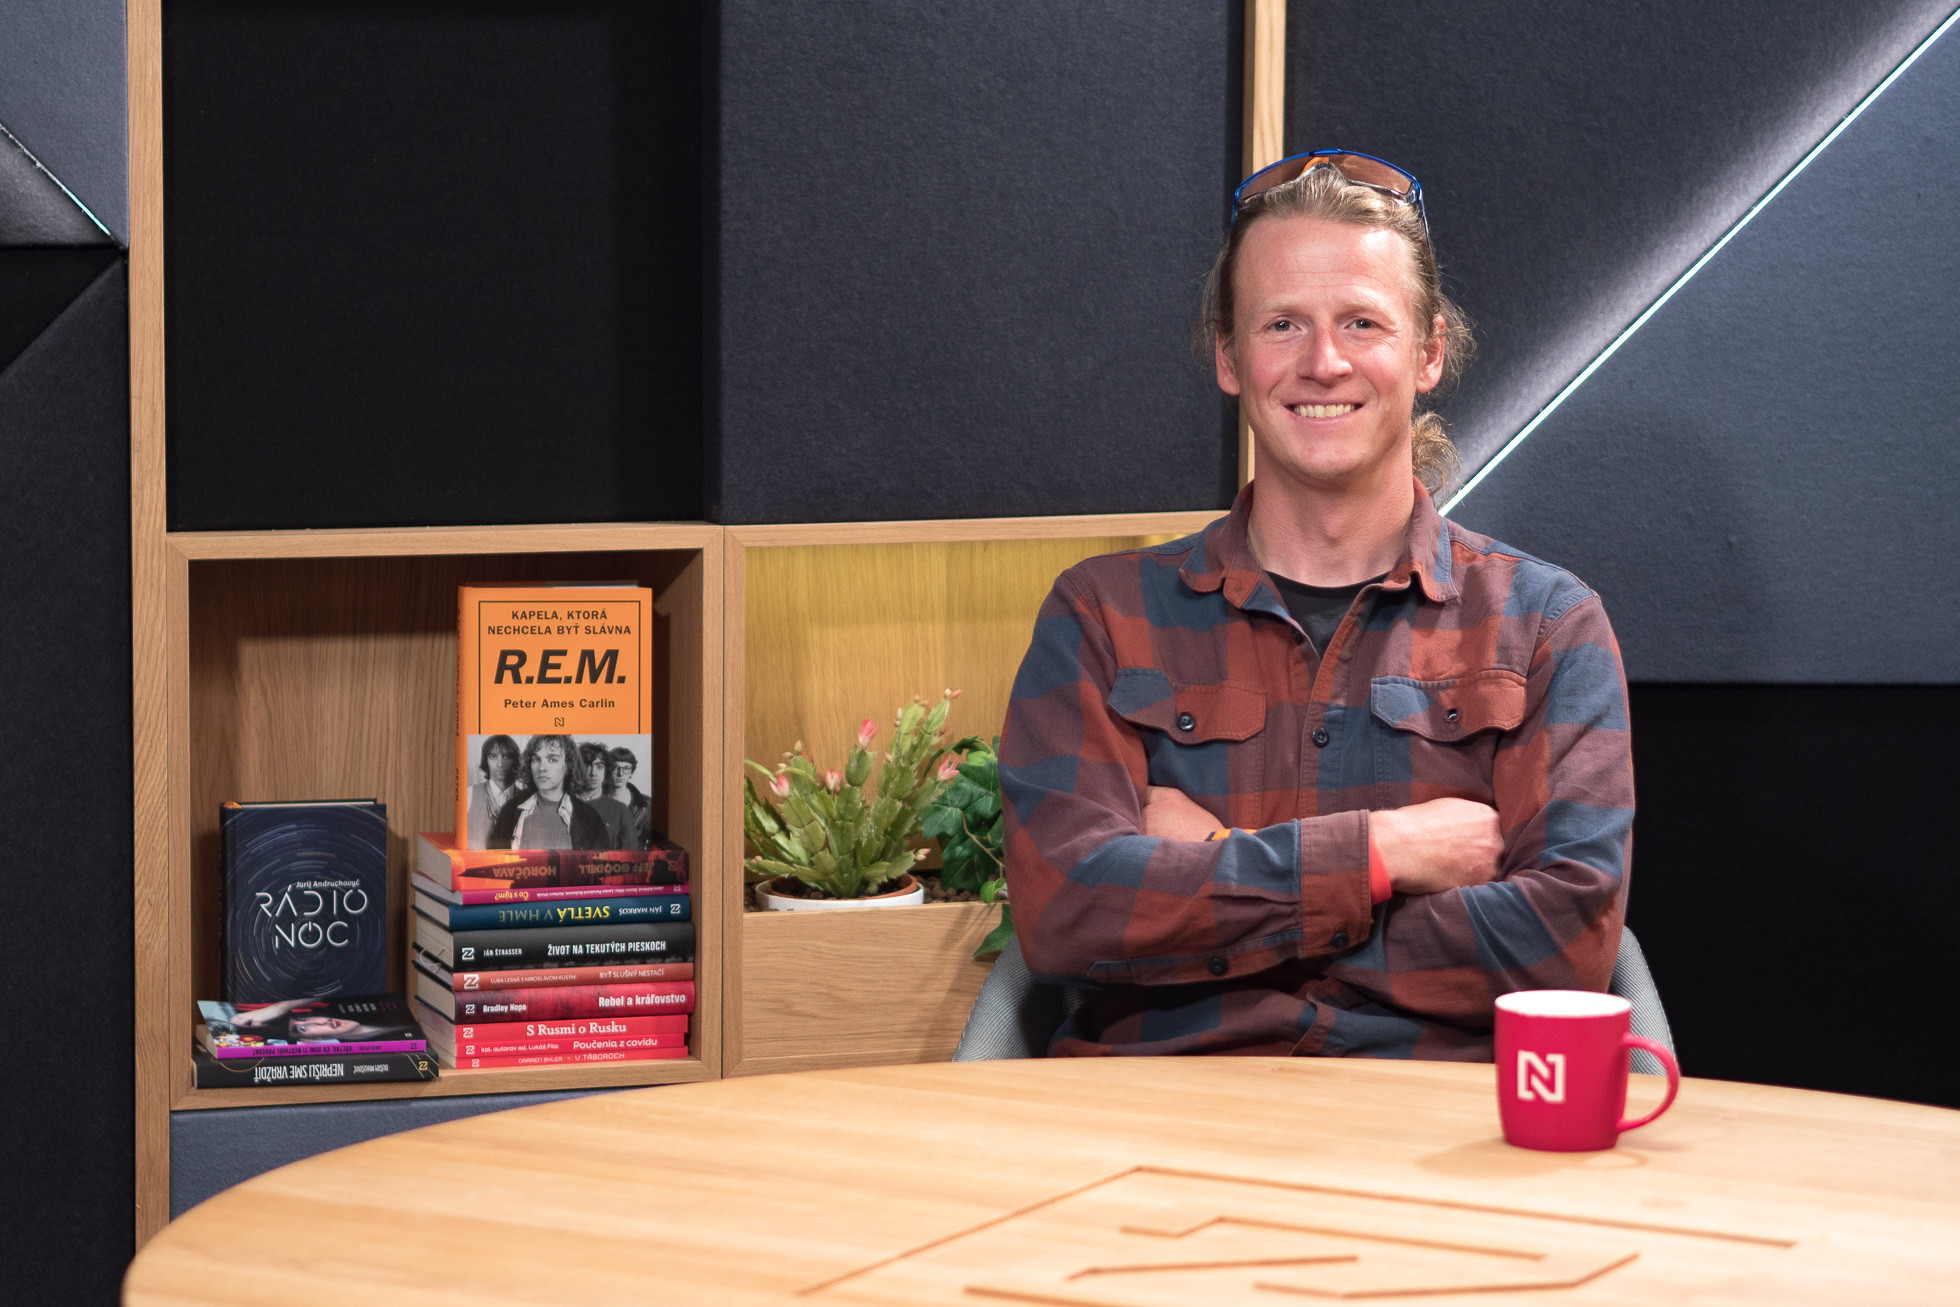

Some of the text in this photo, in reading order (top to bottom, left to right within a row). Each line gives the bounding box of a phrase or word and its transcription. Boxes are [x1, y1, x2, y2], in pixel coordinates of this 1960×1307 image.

[511, 607, 608, 622] KAPELA, KTORÁ
[487, 623, 632, 635] NECHCELA BYŤ SLÁVNA
[494, 649, 626, 684] R.E.M.
[504, 698, 615, 709] Peter Ames Carlin
[492, 865, 557, 879] HORÚČAVA
[579, 863, 630, 876] GOODELL
[296, 880, 312, 889] Jurij
[255, 884, 368, 917] RÁDIO
[494, 891, 512, 900] tým?
[519, 891, 529, 900] Čo
[498, 905, 610, 922] SVETLÁ V HMLE
[618, 905, 662, 916] JÁN MARKOŠ
[275, 920, 349, 948] NOC
[494, 946, 522, 956] ŠTRASSER
[547, 940, 666, 956] ŽIVOT NA TEKUTÝCH PIESKOCH
[599, 967, 664, 979] BYŤ SLUŠNÝ NESTAČÍ
[598, 993, 686, 1008] Rebel a kráľovstvo
[483, 1003, 527, 1014] Bradley Hope
[526, 1020, 627, 1036] S Rusmi o Rusku
[528, 1043, 546, 1051] Lukáš
[573, 1037, 617, 1049] Poučenia
[626, 1037, 657, 1047] covidu
[582, 1052, 625, 1060] TÁBOROCH
[253, 1063, 344, 1083] NEPRIŠLI SME VRAŽDIŤ
